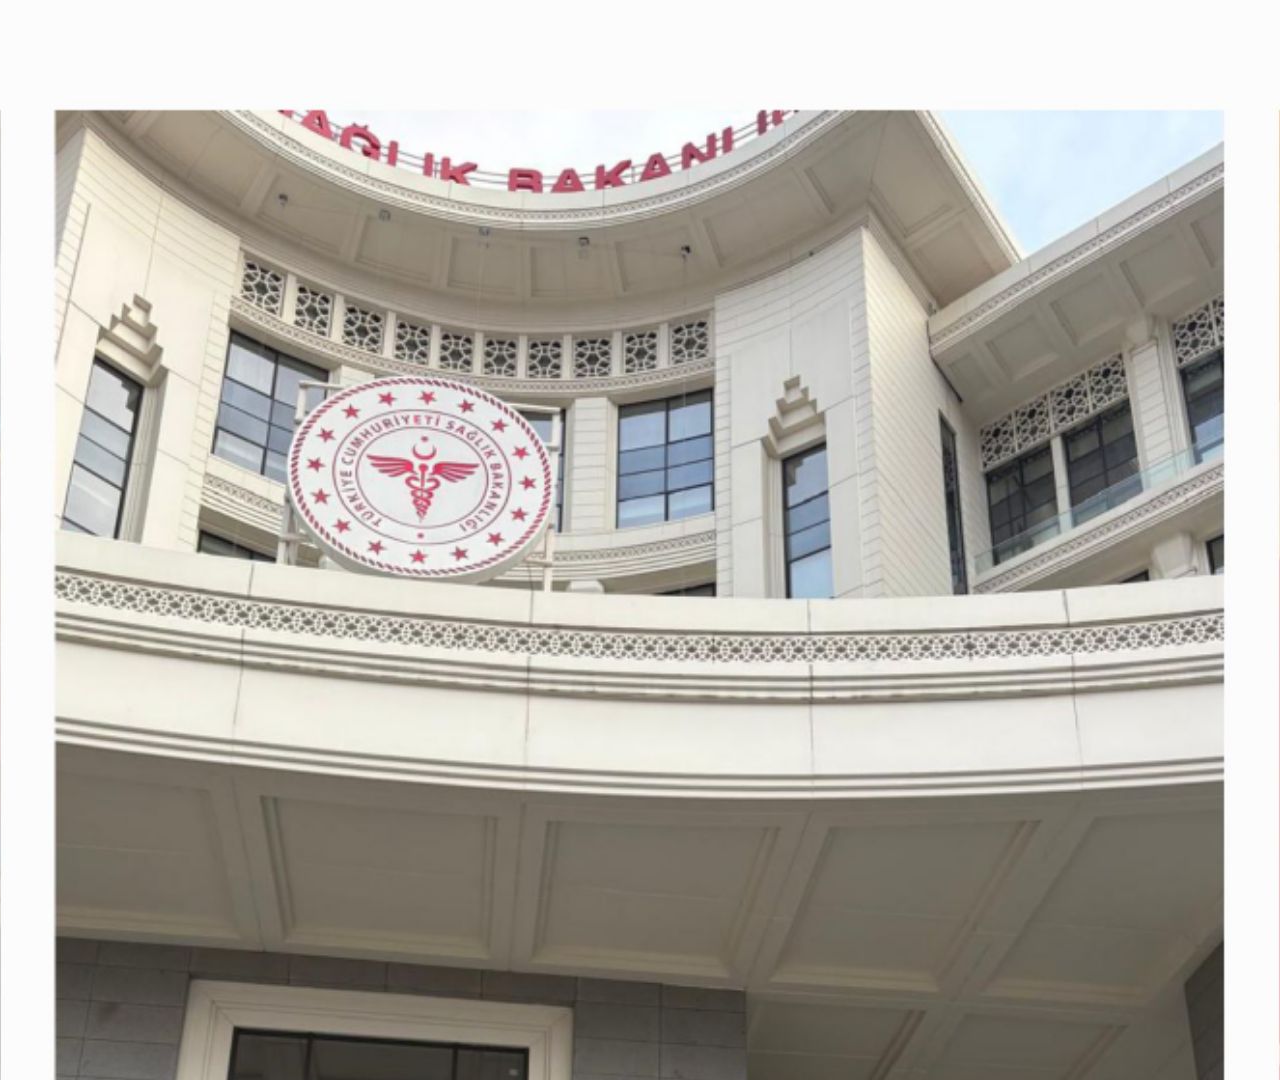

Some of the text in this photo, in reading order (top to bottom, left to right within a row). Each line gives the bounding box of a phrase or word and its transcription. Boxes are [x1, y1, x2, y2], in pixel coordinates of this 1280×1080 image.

[340, 414, 504, 532] TÜRKİYE CUMHURİYETİ SAĞLIK BAKANLIĞI
